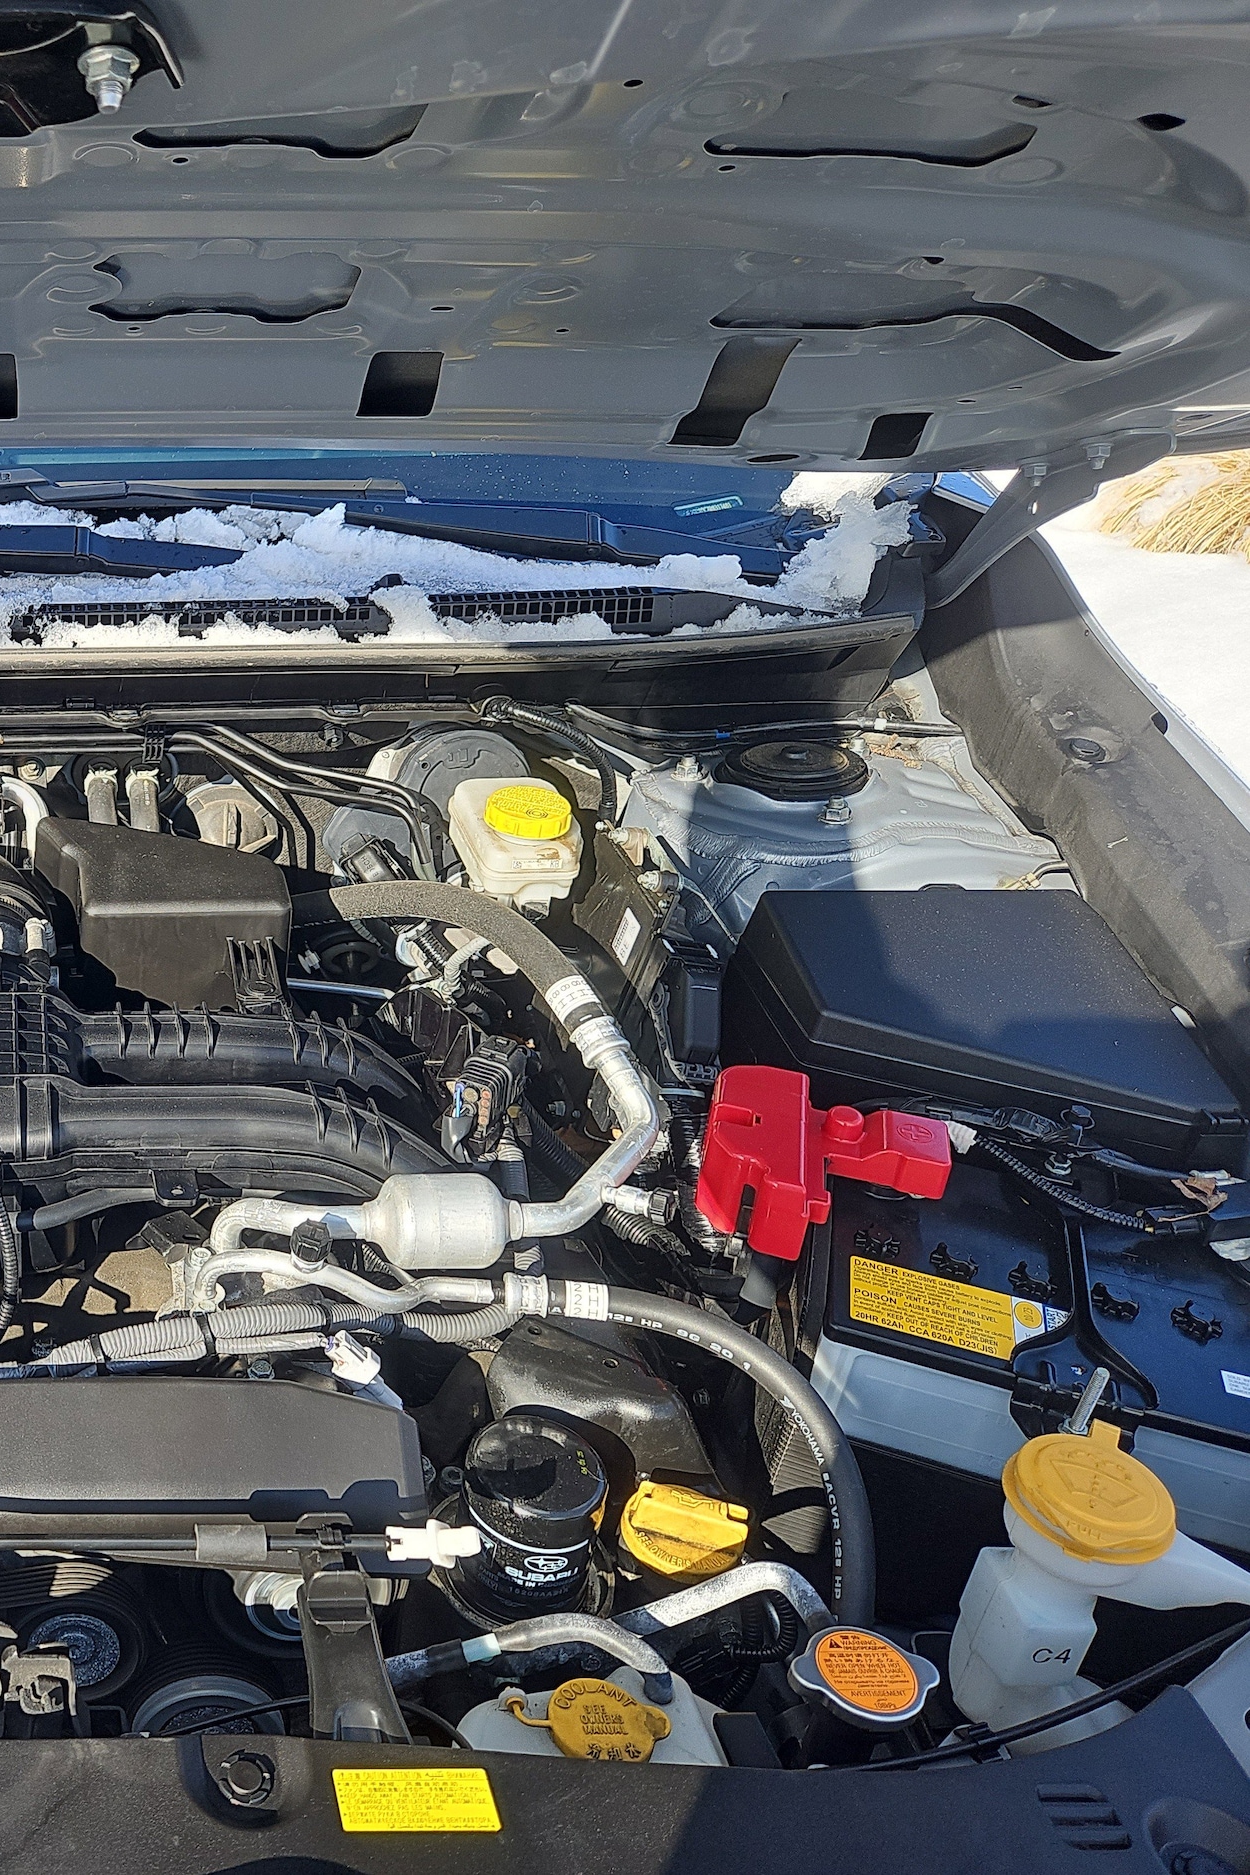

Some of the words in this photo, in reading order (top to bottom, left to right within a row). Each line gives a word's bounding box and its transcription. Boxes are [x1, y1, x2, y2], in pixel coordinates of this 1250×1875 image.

[854, 1258, 898, 1275] DANGER
[902, 1271, 936, 1285] EXPLOSIVE
[573, 1283, 582, 1292] 2
[588, 1284, 599, 1294] H
[854, 1287, 896, 1305] POISON
[574, 1294, 583, 1306] 2
[589, 1295, 599, 1306] H
[640, 1317, 664, 1329] HP
[855, 1310, 879, 1323] 20HR
[880, 1317, 904, 1330] 62Ah
[908, 1324, 929, 1337] CCA
[931, 1330, 954, 1343] 620A
[958, 1338, 997, 1355] D23(JIS)
[791, 1408, 825, 1466] YOKOHAMA
[634, 1529, 654, 1547] SEE
[692, 1553, 730, 1571] MANUAL
[503, 1565, 579, 1582] SUBARU
[1032, 1647, 1071, 1665] C4
[554, 1680, 637, 1709] COOLANT
[582, 1704, 606, 1714] SEE
[579, 1713, 624, 1724] OWNERS
[582, 1724, 628, 1735] MANUAL
